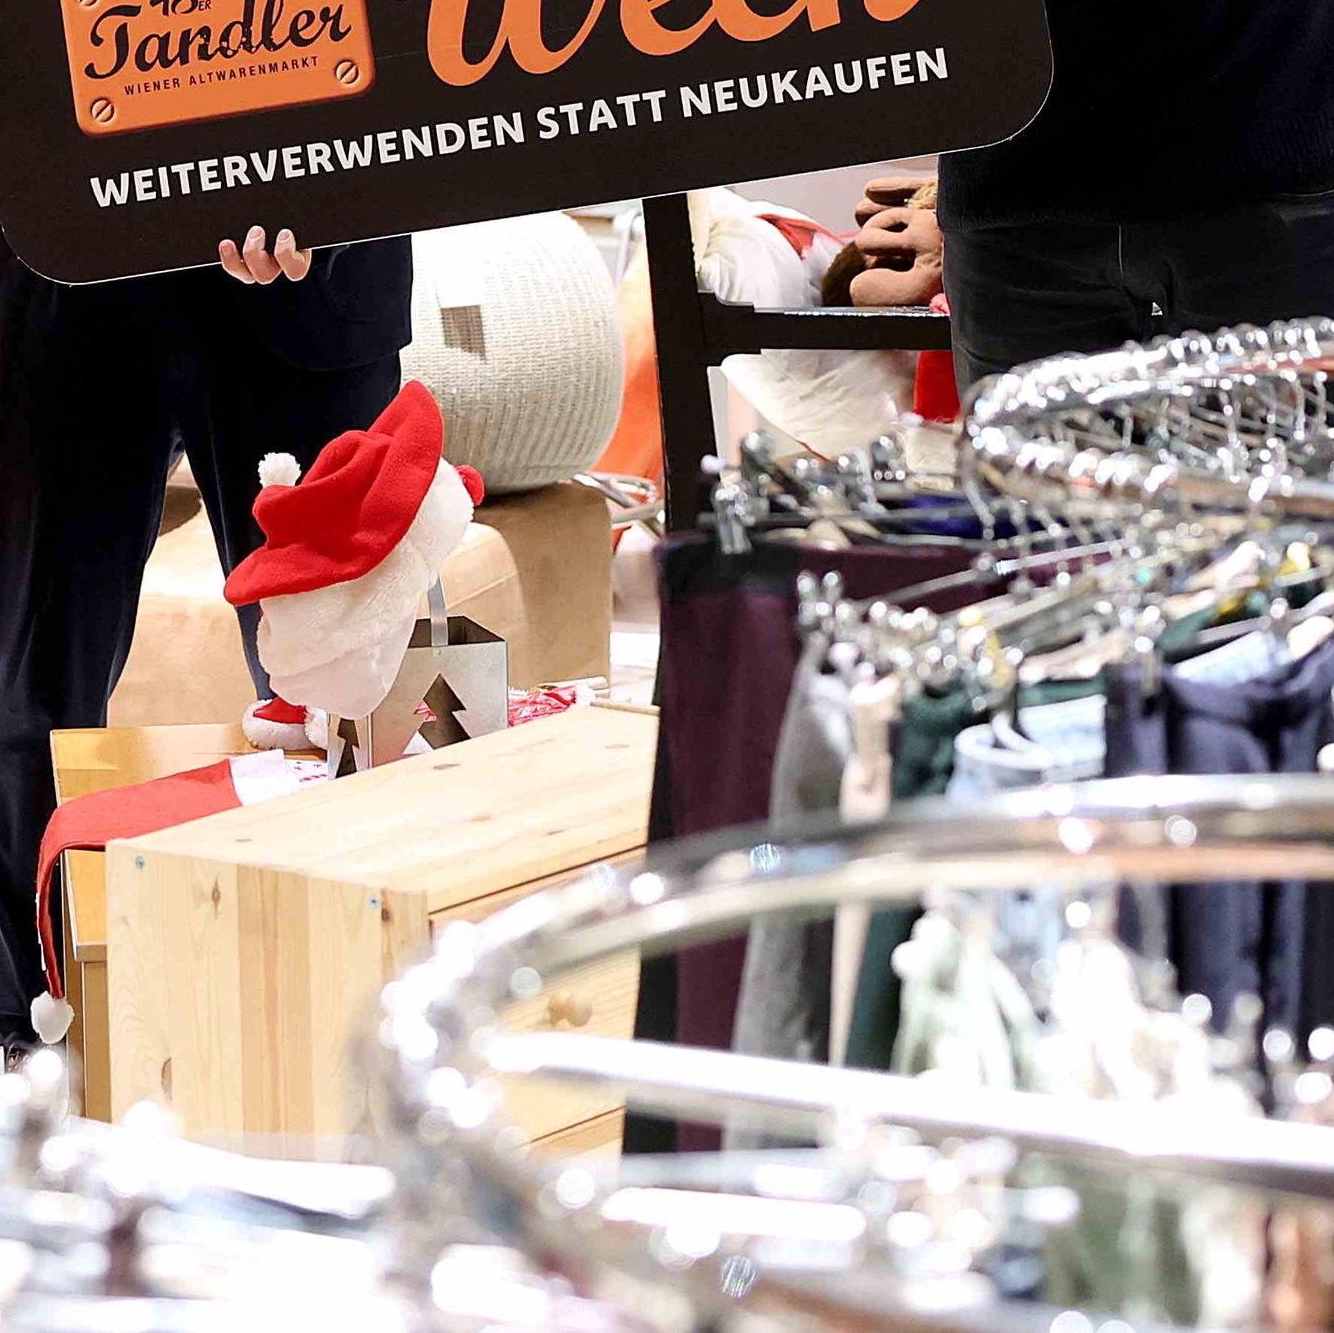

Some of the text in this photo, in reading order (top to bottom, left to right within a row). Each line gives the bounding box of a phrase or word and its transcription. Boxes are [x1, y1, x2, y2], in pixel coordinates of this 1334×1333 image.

[123, 55, 318, 96] WIENER ALTWARENMARKT
[90, 47, 948, 208] WEITERVERWENDEN STATT NEUKAUFEN
